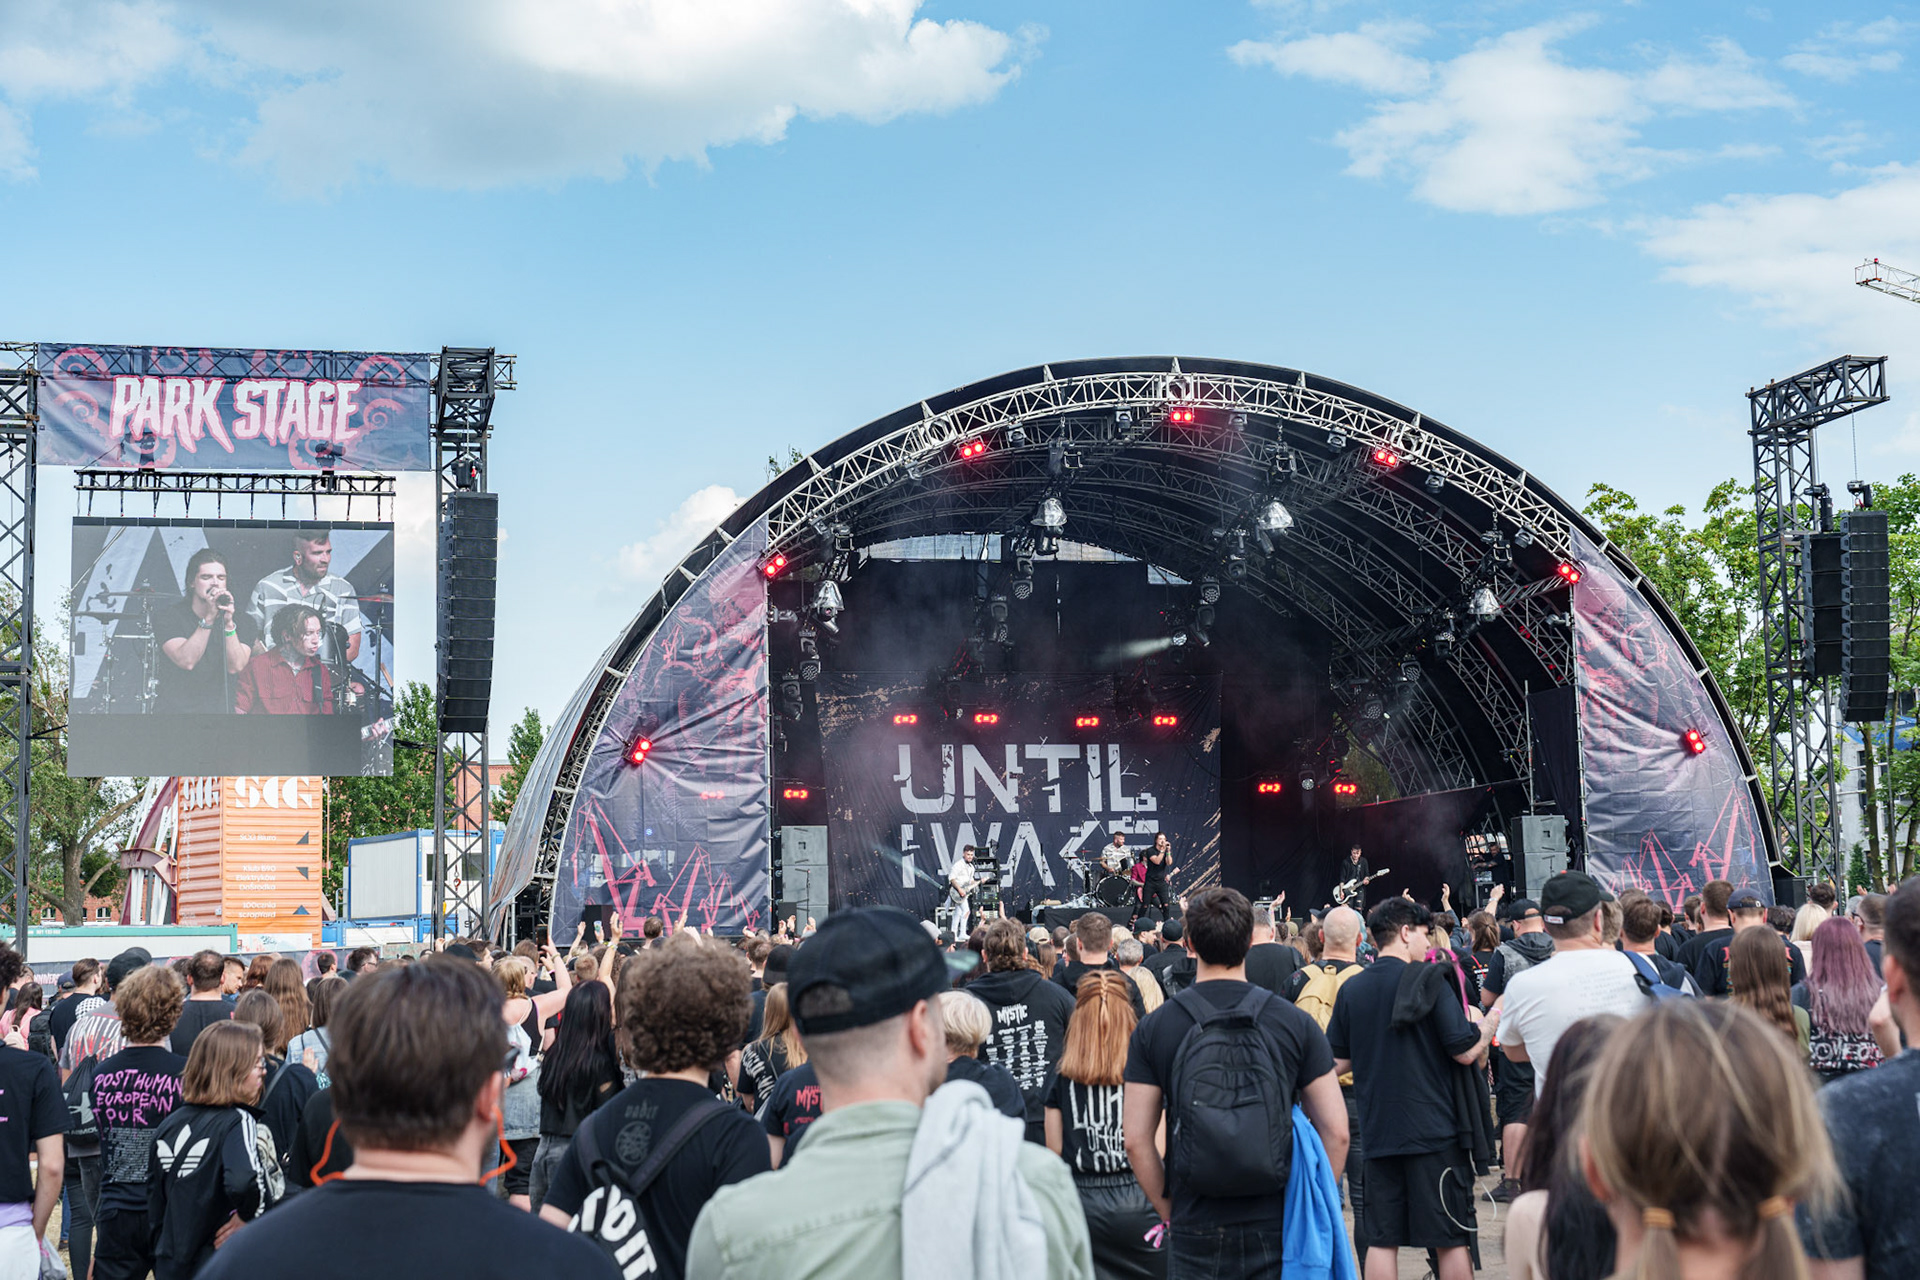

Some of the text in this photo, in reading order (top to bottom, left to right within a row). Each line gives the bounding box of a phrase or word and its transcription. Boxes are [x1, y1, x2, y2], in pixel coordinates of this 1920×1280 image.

[109, 375, 362, 453] PARK STAGE
[894, 743, 1158, 814] UNTIL
[996, 1003, 1028, 1026] MYSTIC
[96, 1091, 173, 1112] EUROPEAN
[92, 1107, 148, 1126] TOUR
